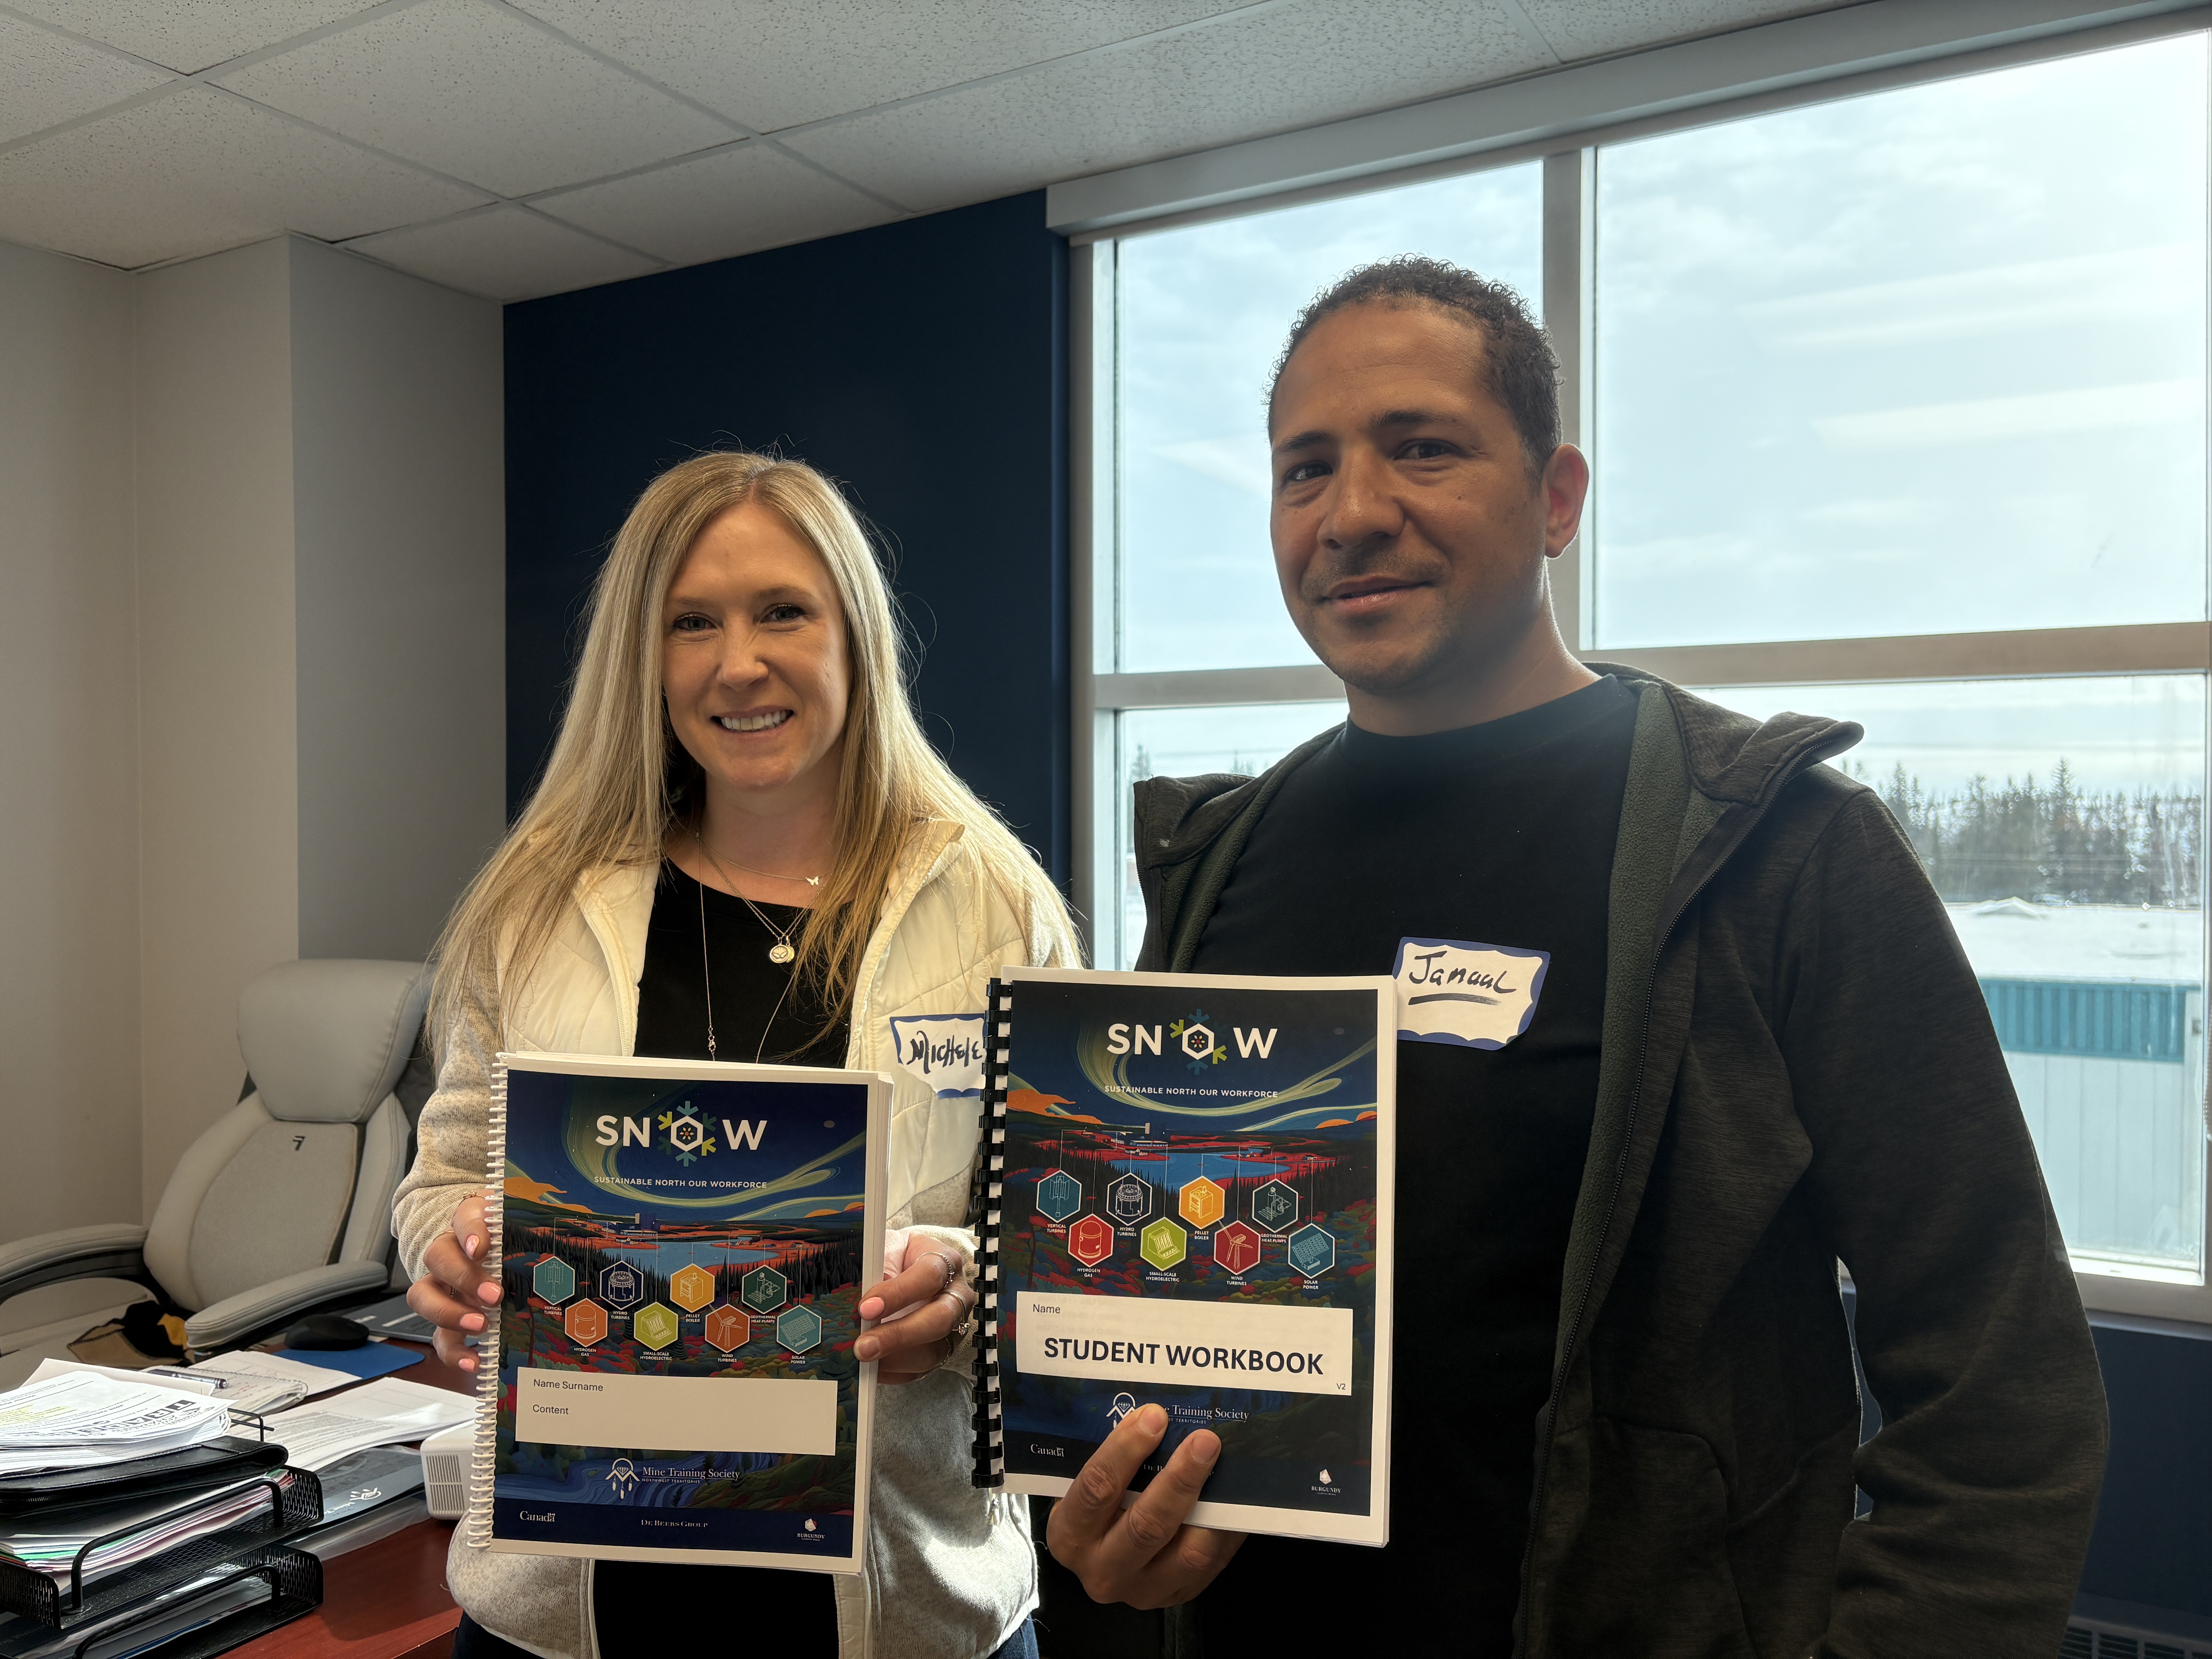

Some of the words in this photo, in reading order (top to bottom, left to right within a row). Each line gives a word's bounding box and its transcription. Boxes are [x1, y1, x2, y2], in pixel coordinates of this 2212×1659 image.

[1106, 1023, 1278, 1060] SNOW
[1104, 1085, 1163, 1094] SUSTAINABLE
[1221, 1089, 1278, 1097] WORKFORCE
[595, 1115, 768, 1152] SNOW
[594, 1176, 653, 1185] SUSTAINABLE
[1032, 1304, 1061, 1314] Name
[1044, 1338, 1160, 1364] STUDENT
[1165, 1345, 1324, 1375] WORKBOOK
[534, 1379, 560, 1389] Name
[562, 1381, 603, 1391] Surname
[533, 1404, 569, 1415] Content
[1172, 1405, 1213, 1420] Training
[1215, 1407, 1249, 1423] Society
[1030, 1444, 1065, 1457] Canada
[642, 1467, 665, 1476] Mine
[668, 1468, 706, 1480] Training
[708, 1469, 740, 1480] Society
[520, 1511, 555, 1522] Canada
